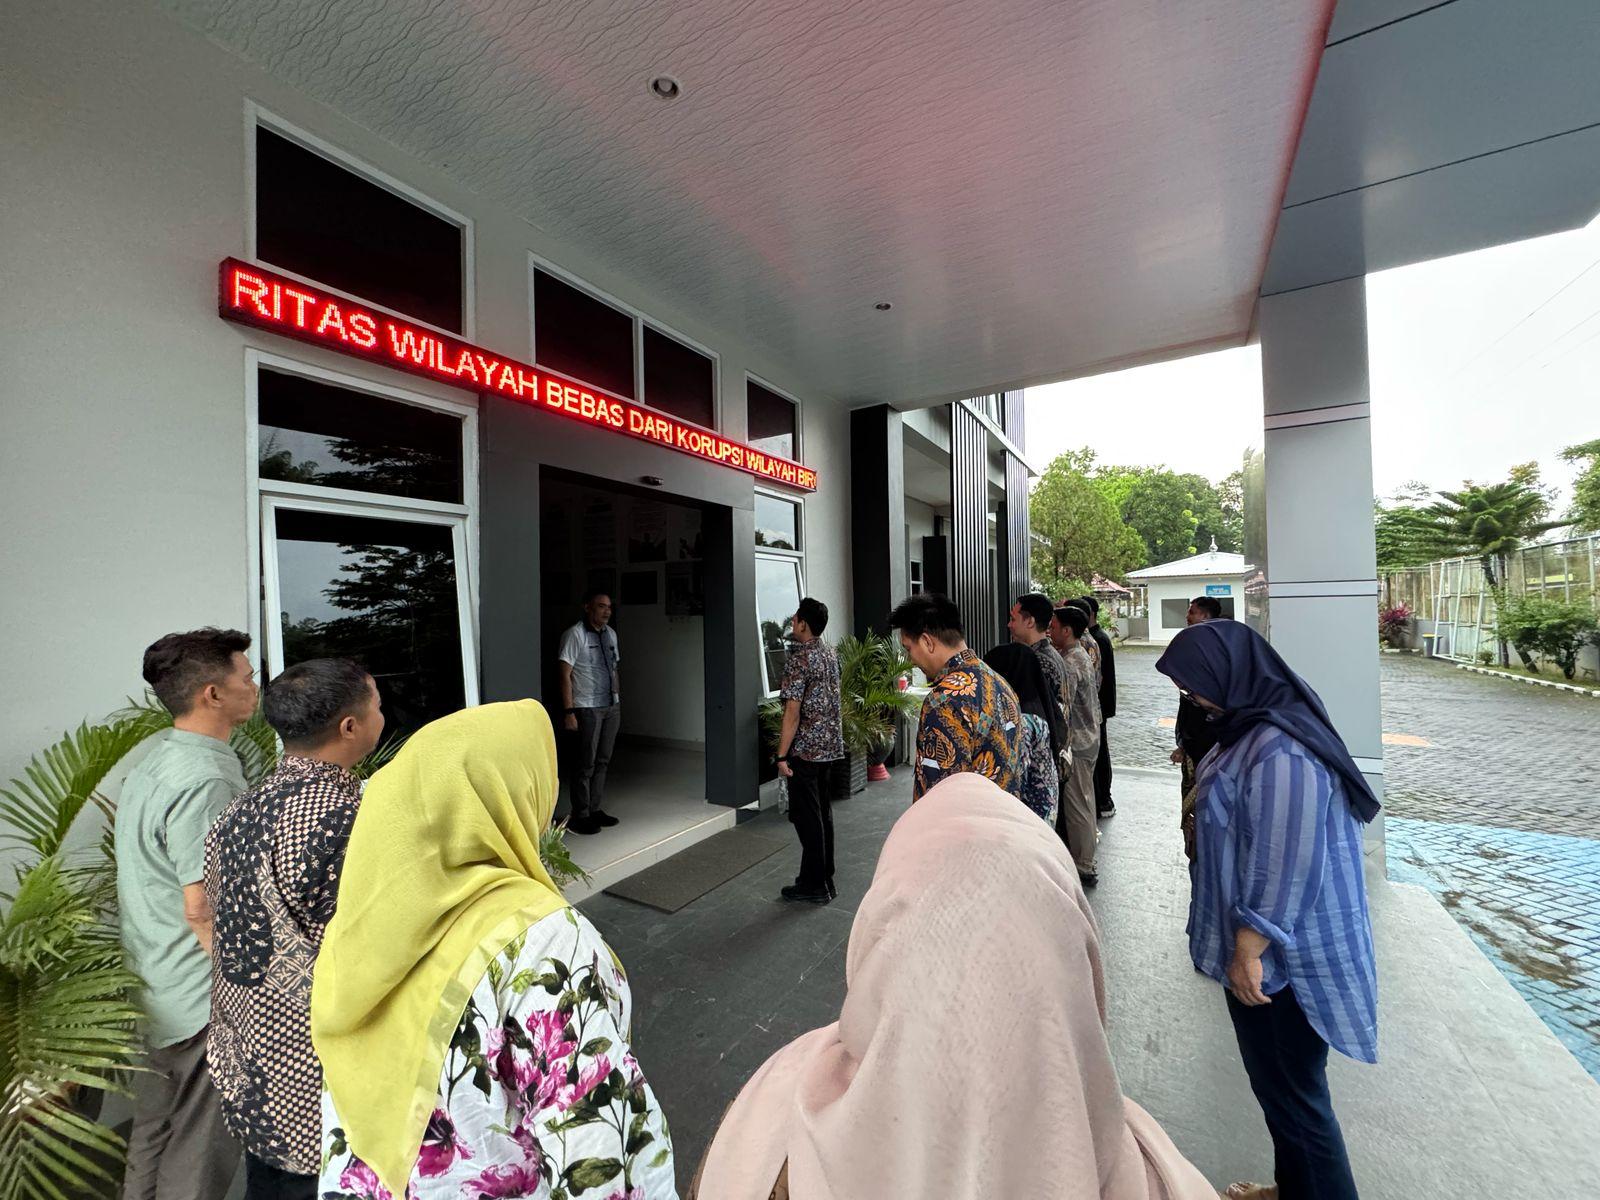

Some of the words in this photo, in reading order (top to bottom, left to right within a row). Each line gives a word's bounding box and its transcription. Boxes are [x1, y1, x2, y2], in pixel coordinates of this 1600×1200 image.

[235, 270, 376, 348] RITAS
[388, 323, 538, 401] WILAYAH
[546, 380, 624, 427] BEBAS
[629, 409, 673, 444] DARI
[677, 426, 744, 466] KORUPSI
[745, 450, 796, 483] WILAYAH
